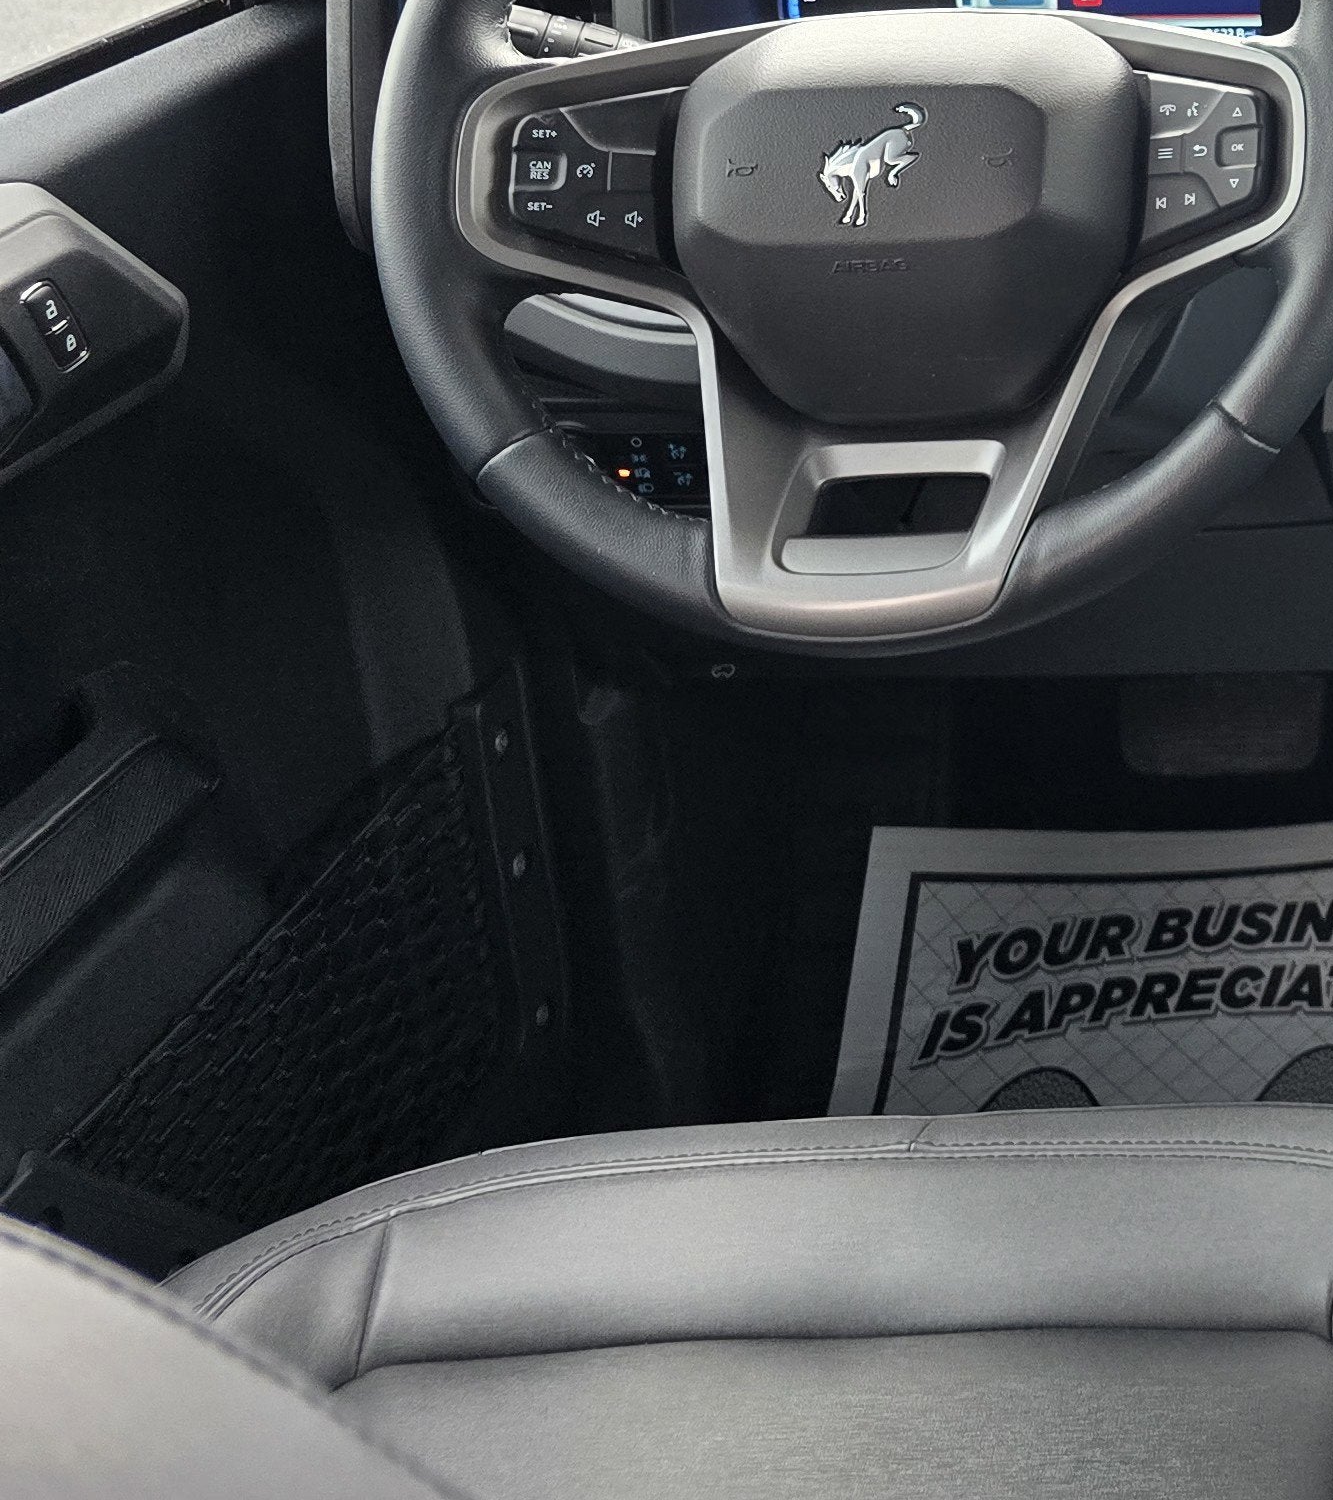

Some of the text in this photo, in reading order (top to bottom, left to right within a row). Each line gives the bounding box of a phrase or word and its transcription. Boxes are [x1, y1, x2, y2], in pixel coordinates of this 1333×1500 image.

[1231, 143, 1244, 152] OK
[529, 160, 551, 170] CAN
[529, 171, 550, 180] RES
[951, 910, 1144, 991] YOUR
[916, 1002, 991, 1064] IS
